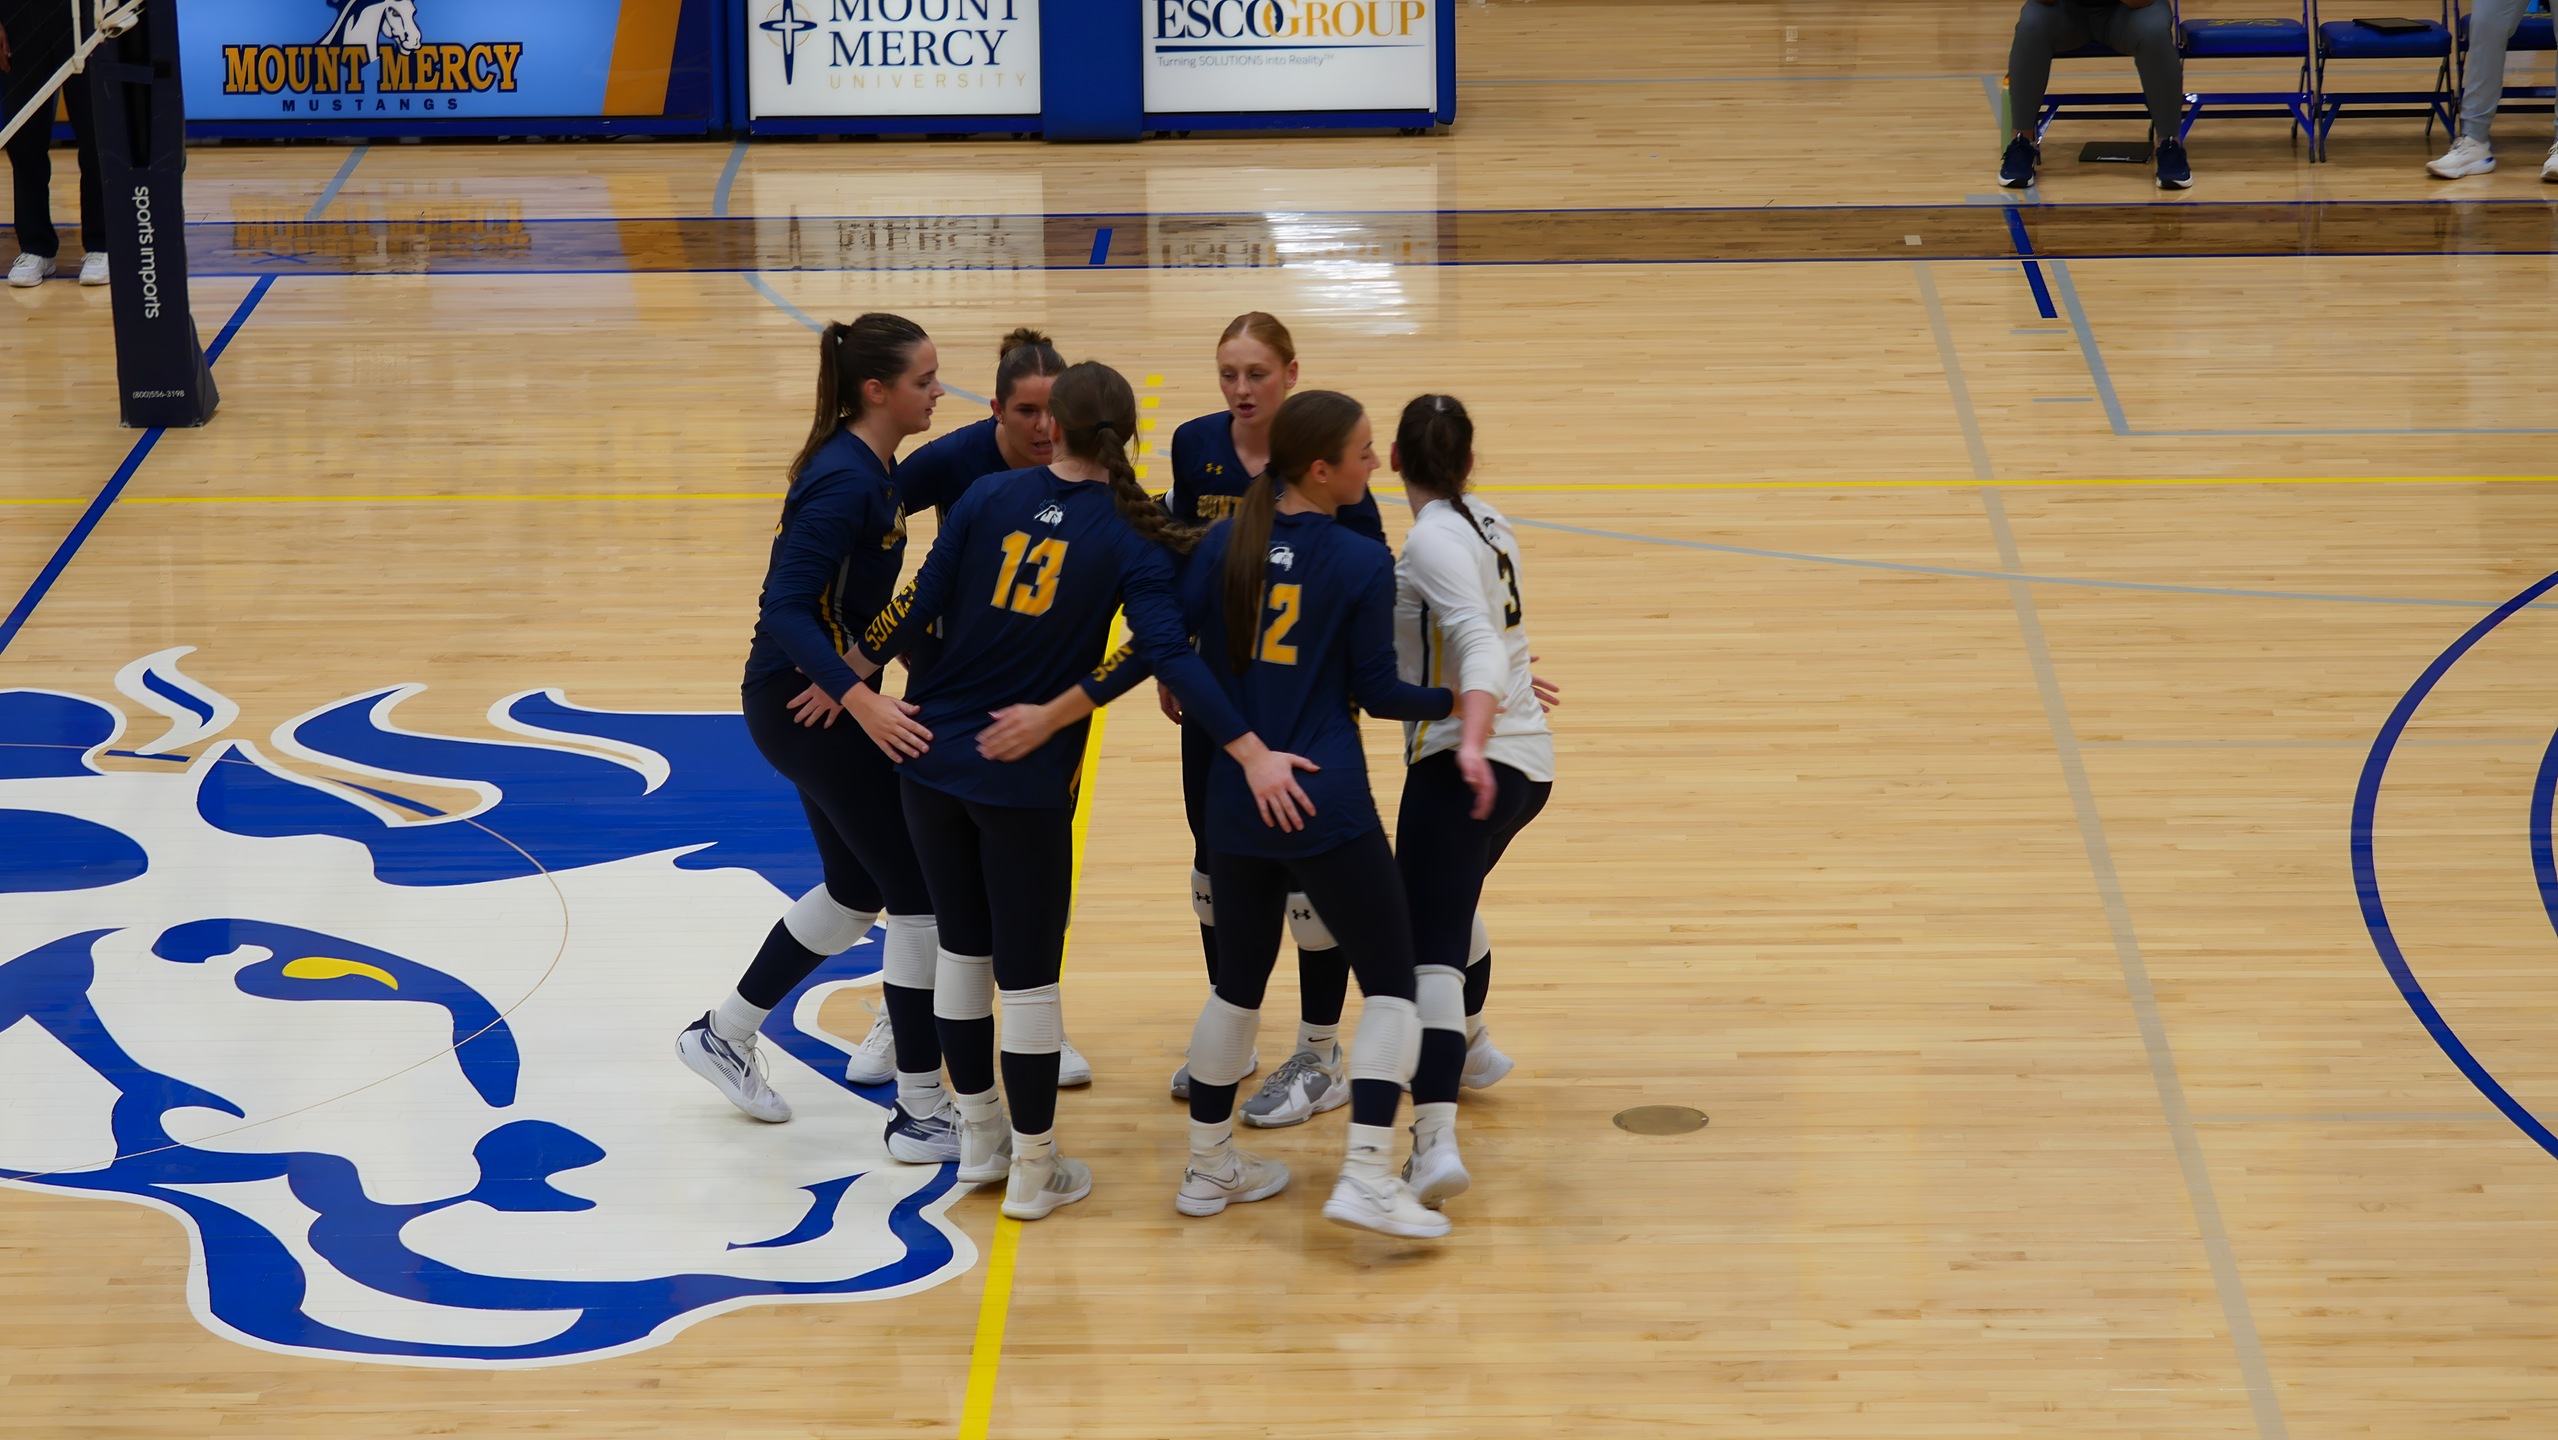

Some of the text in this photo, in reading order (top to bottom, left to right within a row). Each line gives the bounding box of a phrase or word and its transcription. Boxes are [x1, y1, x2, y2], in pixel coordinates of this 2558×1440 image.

[828, 0, 1019, 22] MOUNT
[829, 29, 1008, 67] MERCY
[1157, 56, 1196, 68] Turning
[1198, 55, 1263, 66] SOLUTIONS
[1265, 55, 1286, 65] into
[223, 42, 523, 94] MOUNT MERCY
[829, 73, 1026, 89] UNIVERSITY
[282, 98, 458, 112] MUSTANGS
[132, 186, 161, 319] sports imports
[990, 530, 1069, 617] 13
[1496, 551, 1522, 632] 3
